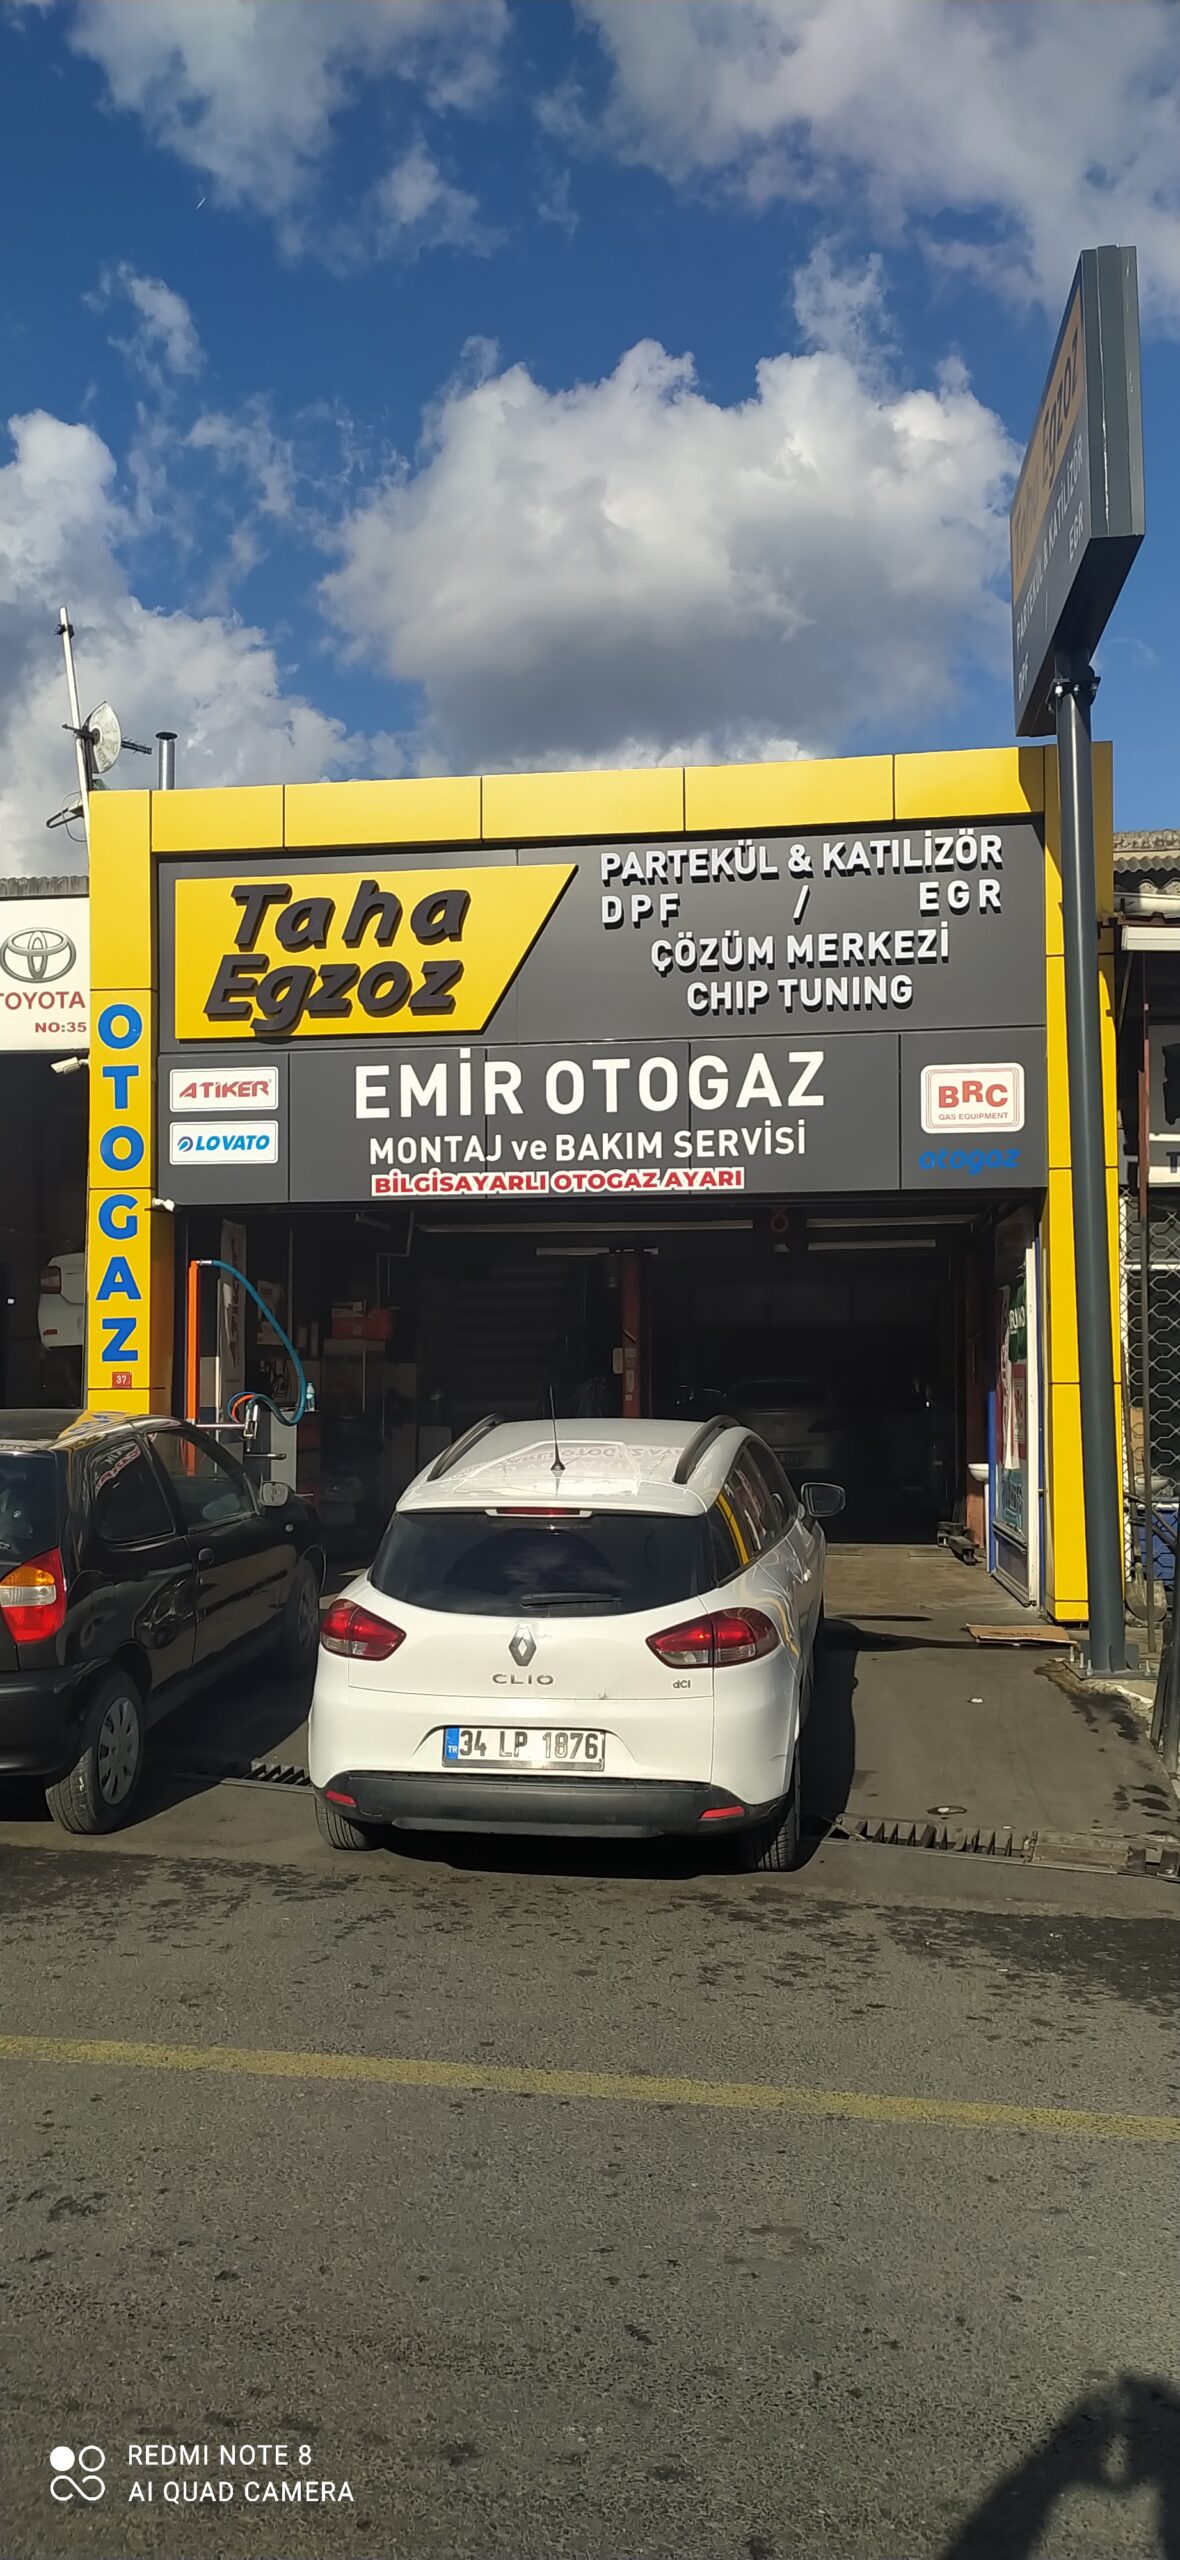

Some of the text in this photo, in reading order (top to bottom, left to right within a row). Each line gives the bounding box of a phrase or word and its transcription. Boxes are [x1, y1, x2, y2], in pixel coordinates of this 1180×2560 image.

[1042, 324, 1078, 489] Egzoz
[1069, 500, 1084, 564] EGR
[1043, 538, 1049, 571] &
[601, 828, 1003, 883] PARTEKÜL & KATILİZÖR
[231, 879, 471, 952] Taha
[602, 878, 1002, 928] DPF / EGR
[651, 921, 949, 975] ÇÖZÜM MERKEZİ
[203, 953, 464, 1040] Egzoz
[687, 974, 914, 1014] CHIP TUNING
[35, 1022, 87, 1033] NO:35
[355, 1048, 825, 1119] EMİR OTOGAZ
[938, 1080, 1008, 1109] BRC
[938, 1111, 1009, 1121] GAS EQUIPMENT
[195, 1135, 270, 1151] LOVATO
[369, 1119, 805, 1165] MONTAJ ve BAKIM SERVİSİ
[918, 1146, 1022, 1176] otogaz
[95, 1003, 145, 1362] OTOGAZ
[374, 1169, 742, 1194] BİLGİSAYARLI OTOGAZ AYARI
[116, 1375, 127, 1385] 37
[492, 1673, 554, 1685] CLIO
[447, 1730, 599, 1759] TR 34 LP 1876
